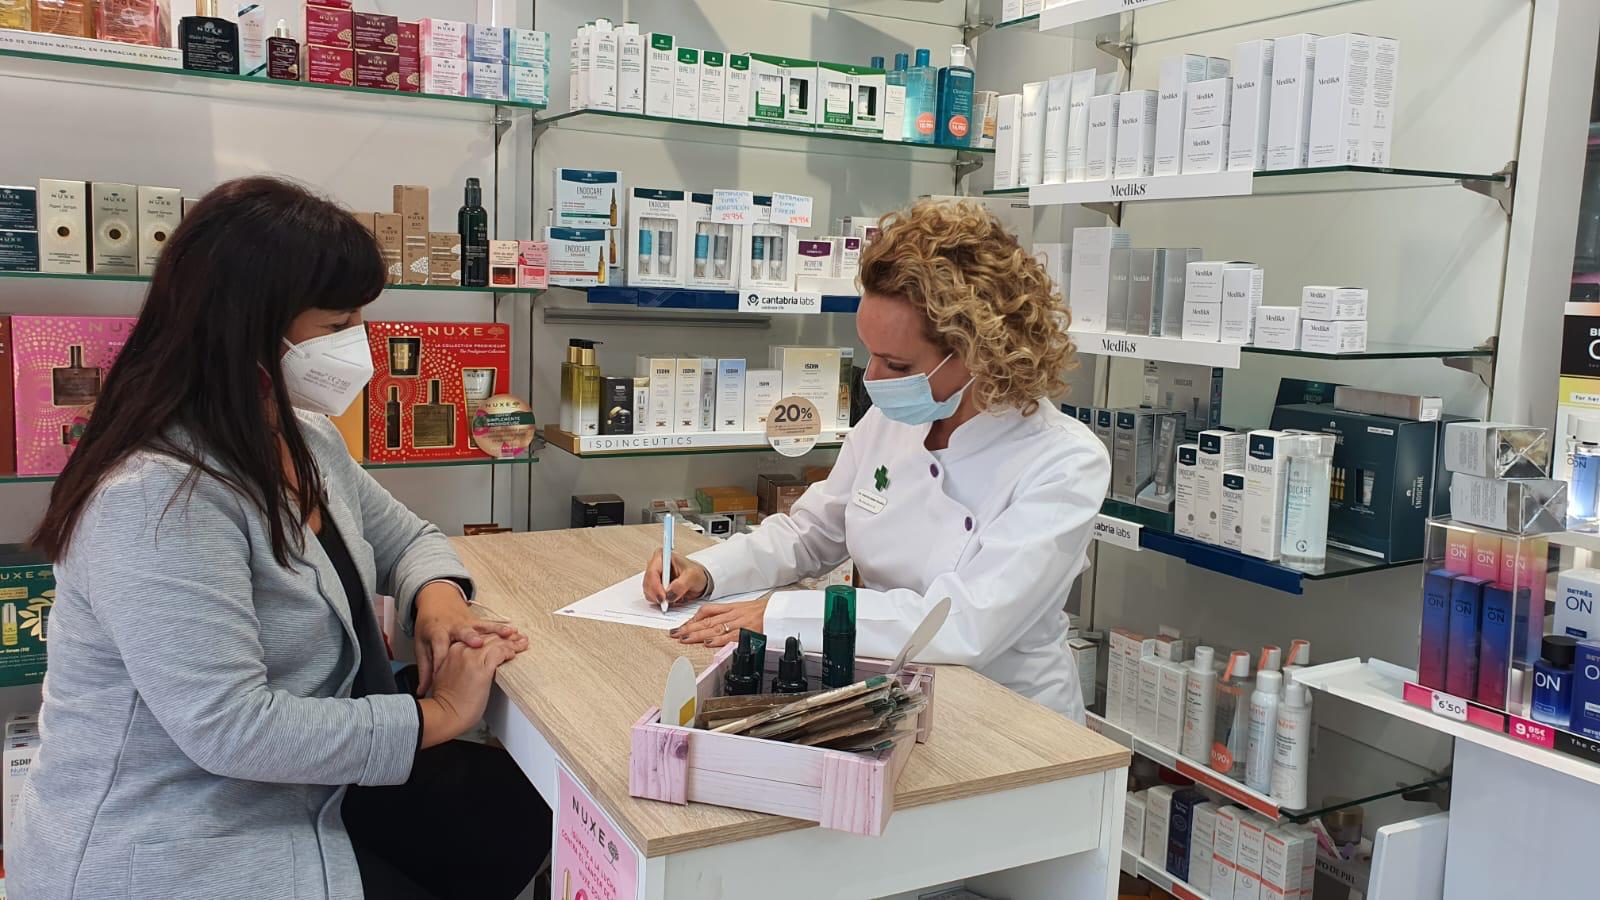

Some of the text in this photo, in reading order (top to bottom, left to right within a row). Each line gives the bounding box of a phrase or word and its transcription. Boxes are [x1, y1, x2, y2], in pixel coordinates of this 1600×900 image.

[56, 43, 87, 52] NATURAL
[1110, 183, 1147, 196] Medik8
[1226, 291, 1246, 299] Medik8
[762, 298, 814, 306] cantabria labs
[1266, 314, 1285, 322] Medik8
[428, 326, 484, 336] NUXE
[1101, 339, 1137, 353] Medik8
[774, 404, 812, 424] 20%
[590, 437, 692, 449] ISDINCEUTICS
[1416, 476, 1424, 509] ENDOCARE
[1116, 528, 1131, 539] labs
[1451, 548, 1467, 560] ON
[1478, 554, 1494, 566] ON
[1567, 587, 1592, 598] BETRÉS
[1428, 598, 1444, 610] ON
[1455, 604, 1472, 616] ON
[1566, 597, 1592, 614] ON
[1487, 612, 1505, 624] ON
[1535, 672, 1561, 692] ON
[1570, 738, 1584, 748] The
[572, 796, 606, 848] NUXE
